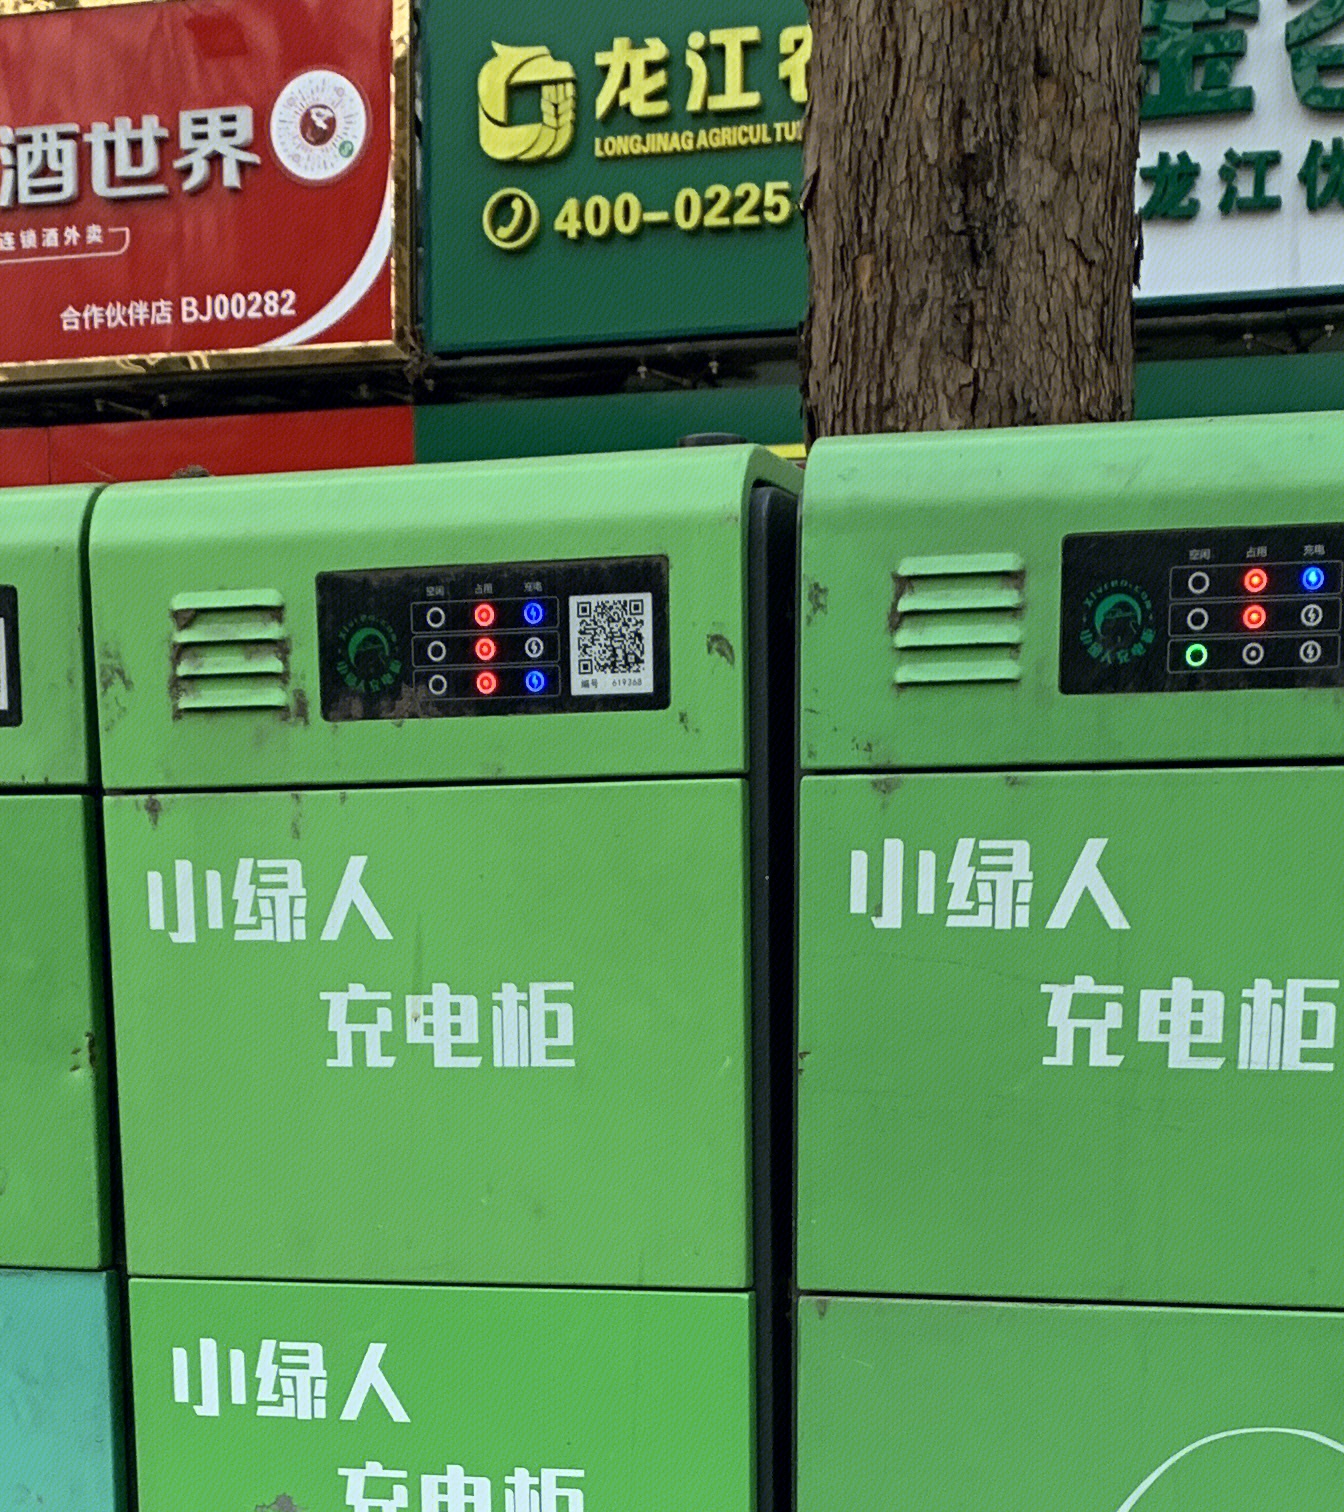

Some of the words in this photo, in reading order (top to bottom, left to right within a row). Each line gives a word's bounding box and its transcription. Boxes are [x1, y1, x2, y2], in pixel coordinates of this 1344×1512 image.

[594, 130, 695, 158] LONGJINAG
[553, 180, 798, 240] 400-0225
[59, 298, 174, 331] 合作伙伴店
[180, 288, 297, 323] BJ00282
[146, 855, 394, 943] 小绿人
[849, 837, 1131, 930] 小绿人
[319, 981, 576, 1068] 充电柜
[1040, 975, 1341, 1072] 充电柜
[172, 1337, 411, 1423] 小绿人
